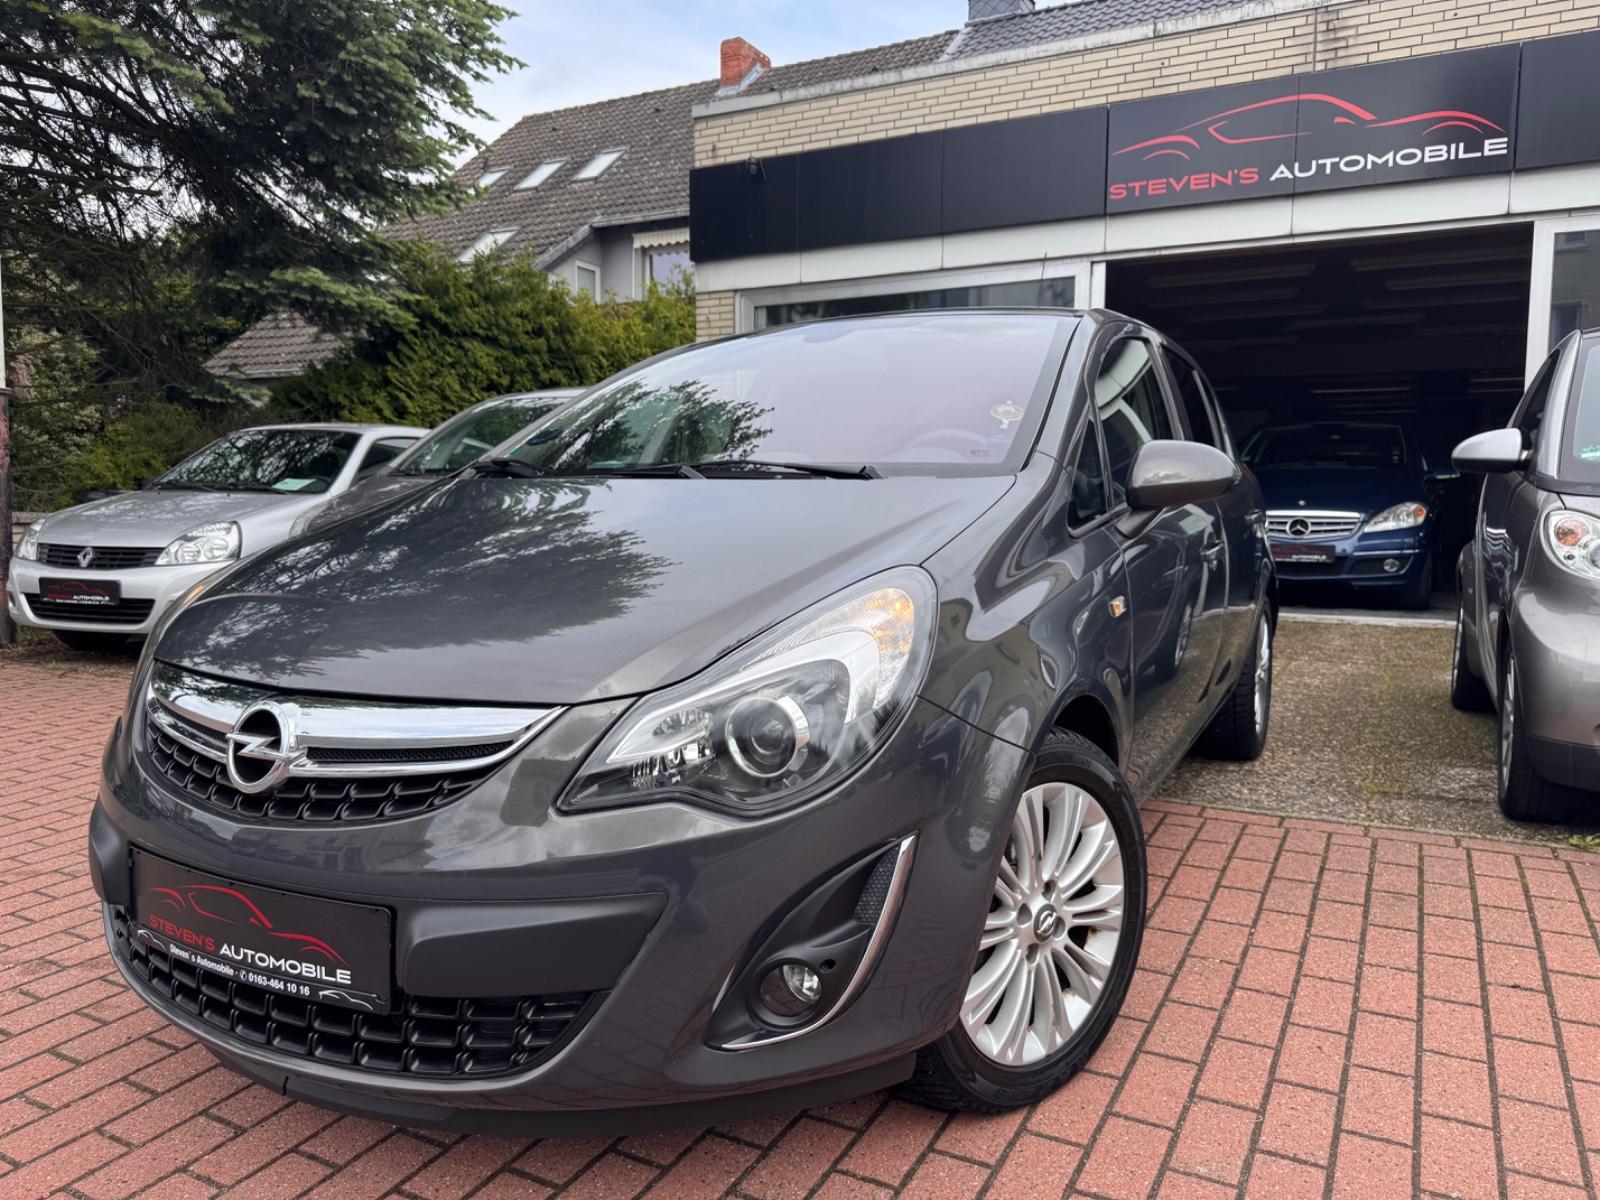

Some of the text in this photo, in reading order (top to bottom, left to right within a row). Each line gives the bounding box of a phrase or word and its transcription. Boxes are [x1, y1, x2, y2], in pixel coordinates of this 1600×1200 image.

[1109, 136, 1508, 200] STEVEN'S AUTOMOBILE
[150, 914, 352, 985] STEVEN'S AUTOMOBILE
[196, 955, 235, 977] Automobile
[248, 972, 285, 990] 0163-464
[286, 983, 297, 994] 10
[298, 985, 310, 997] 16
